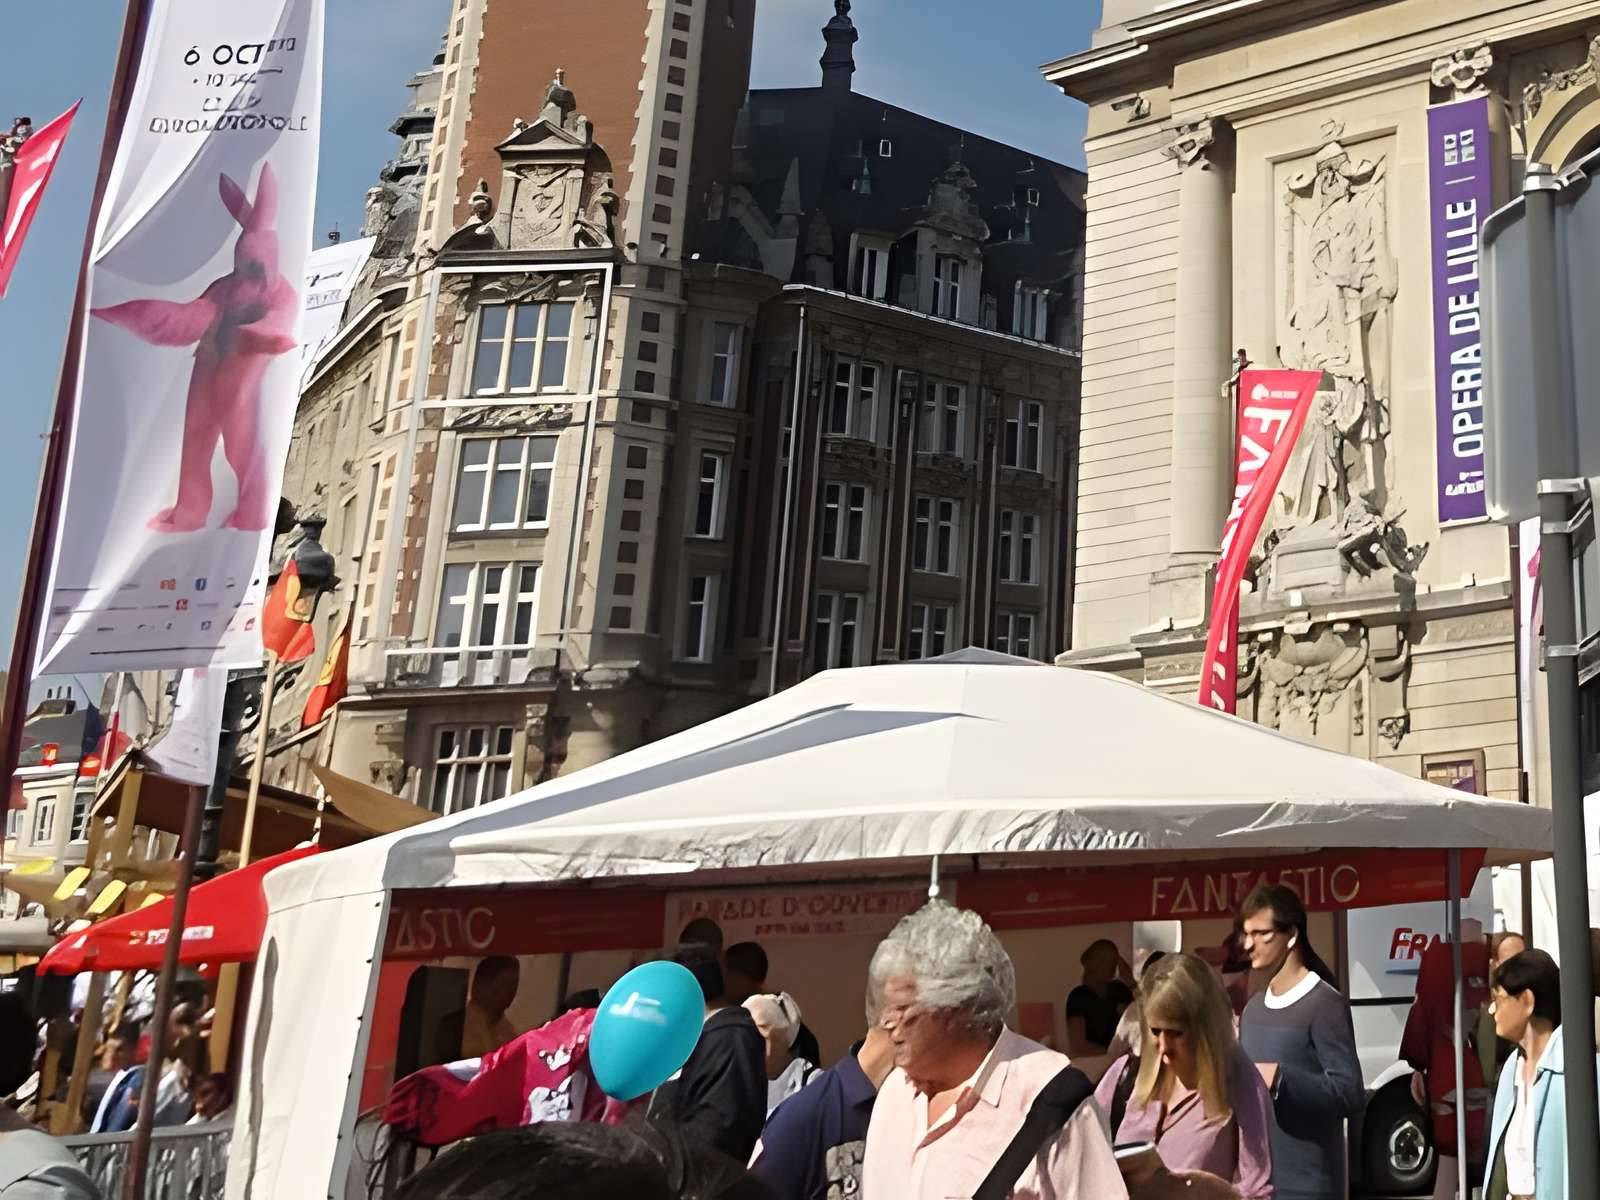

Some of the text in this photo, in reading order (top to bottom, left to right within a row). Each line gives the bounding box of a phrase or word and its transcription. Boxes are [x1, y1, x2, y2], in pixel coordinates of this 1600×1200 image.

[184, 45, 201, 65] 6
[1446, 198, 1479, 285] LILLE
[1448, 291, 1480, 336] DE
[1450, 344, 1484, 458] OPERA
